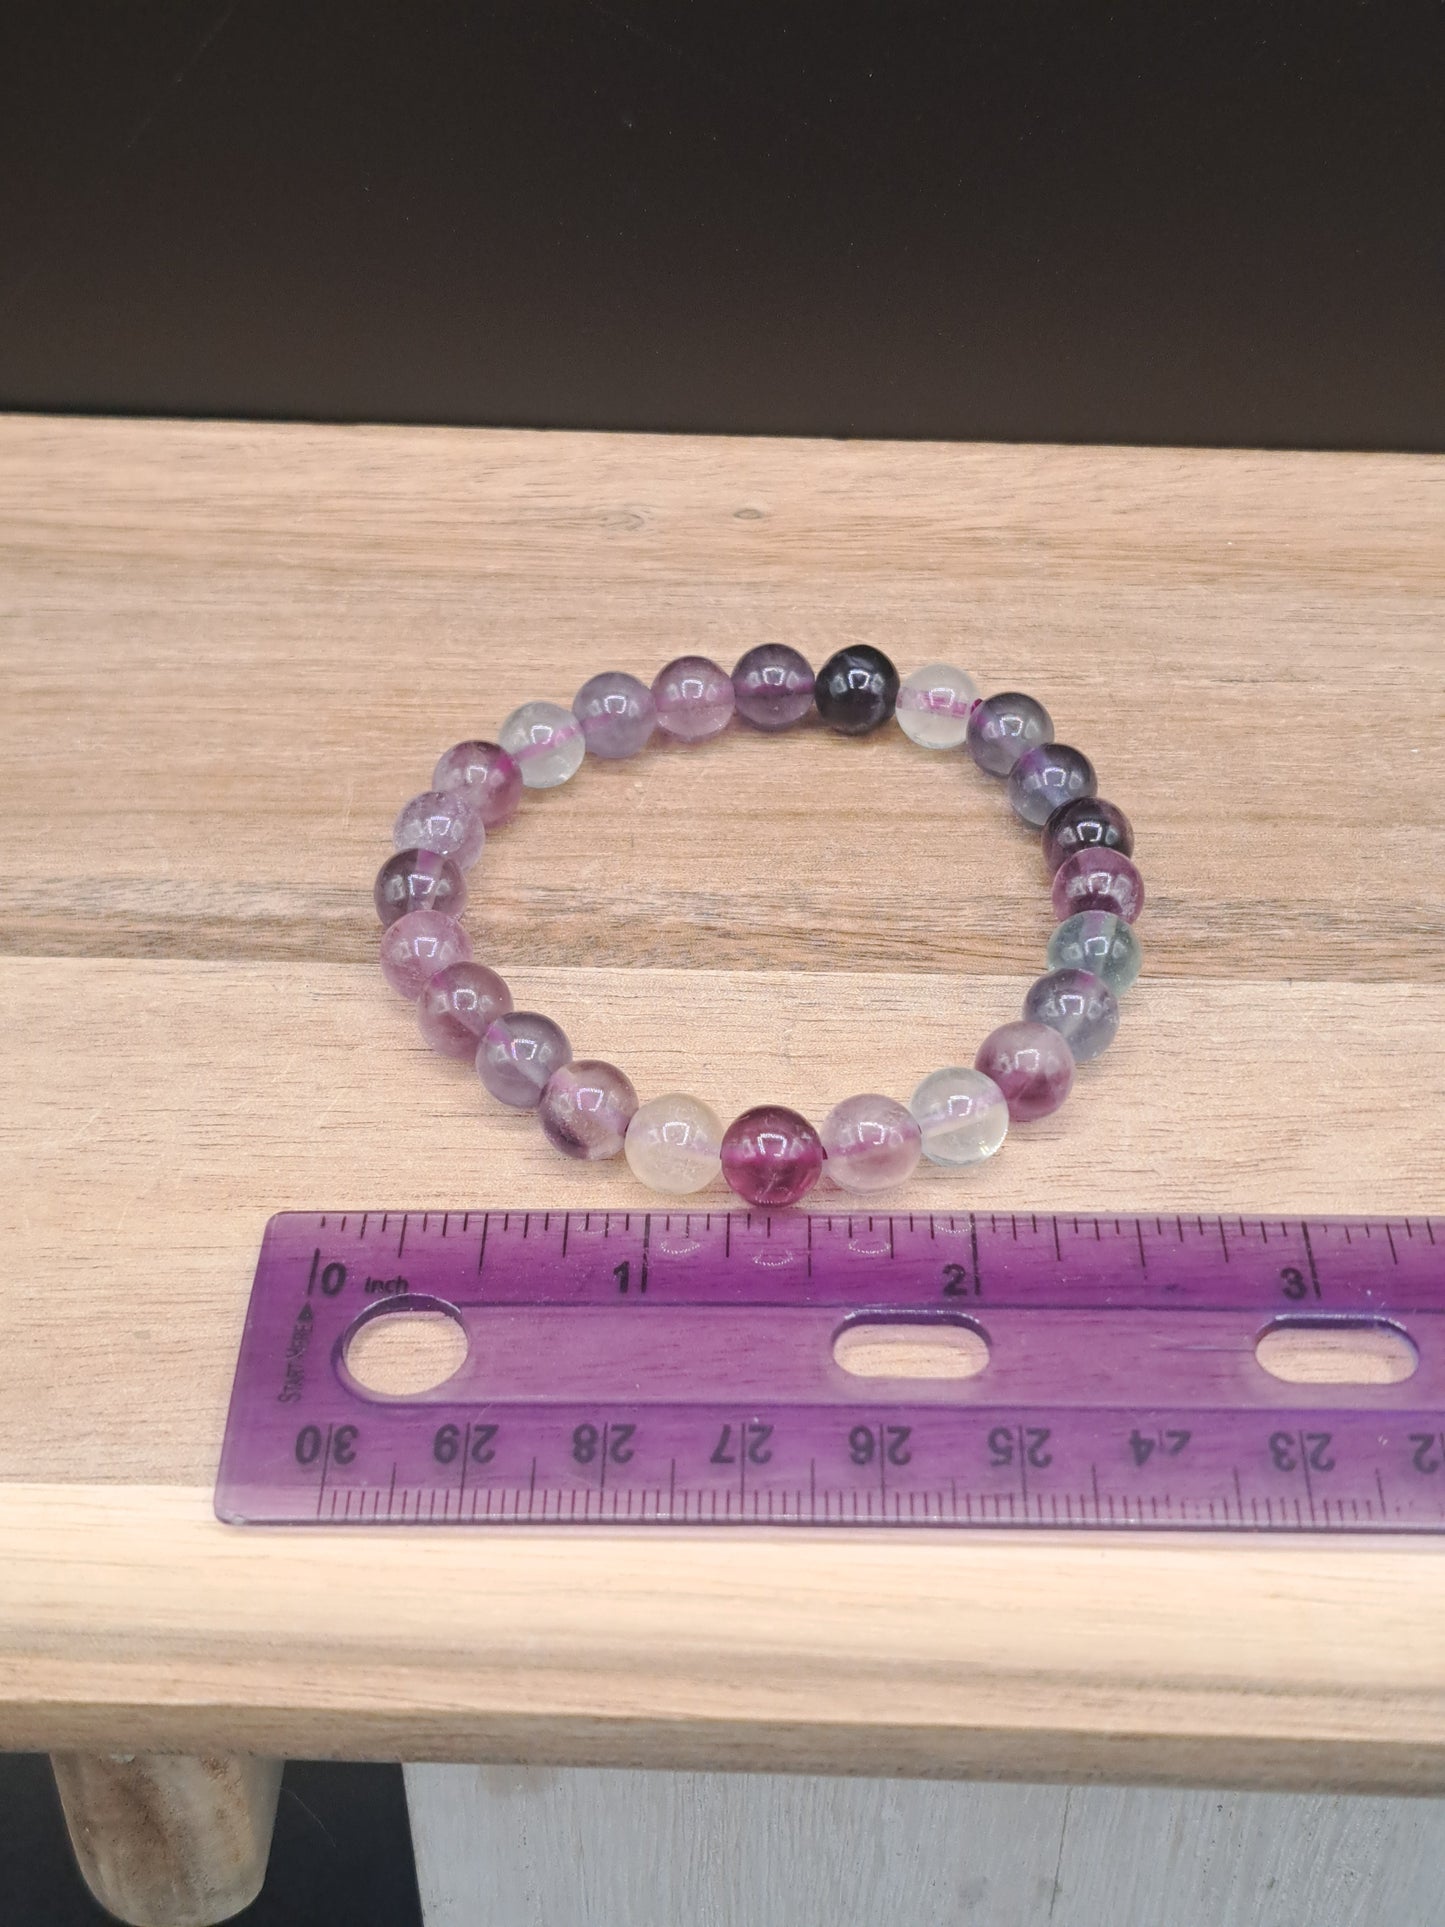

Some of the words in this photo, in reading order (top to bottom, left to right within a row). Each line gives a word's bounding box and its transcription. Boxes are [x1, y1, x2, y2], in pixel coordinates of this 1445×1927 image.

[321, 1262, 346, 1297] 0
[613, 1261, 630, 1294] 1
[942, 1263, 967, 1297] 2
[1280, 1267, 1307, 1300] 3
[296, 1424, 359, 1465] 30
[433, 1423, 499, 1464] 29
[572, 1423, 636, 1464] 28
[710, 1423, 774, 1464] 27
[849, 1425, 912, 1466] 26
[987, 1427, 1052, 1469] 25
[1268, 1432, 1335, 1472] 23
